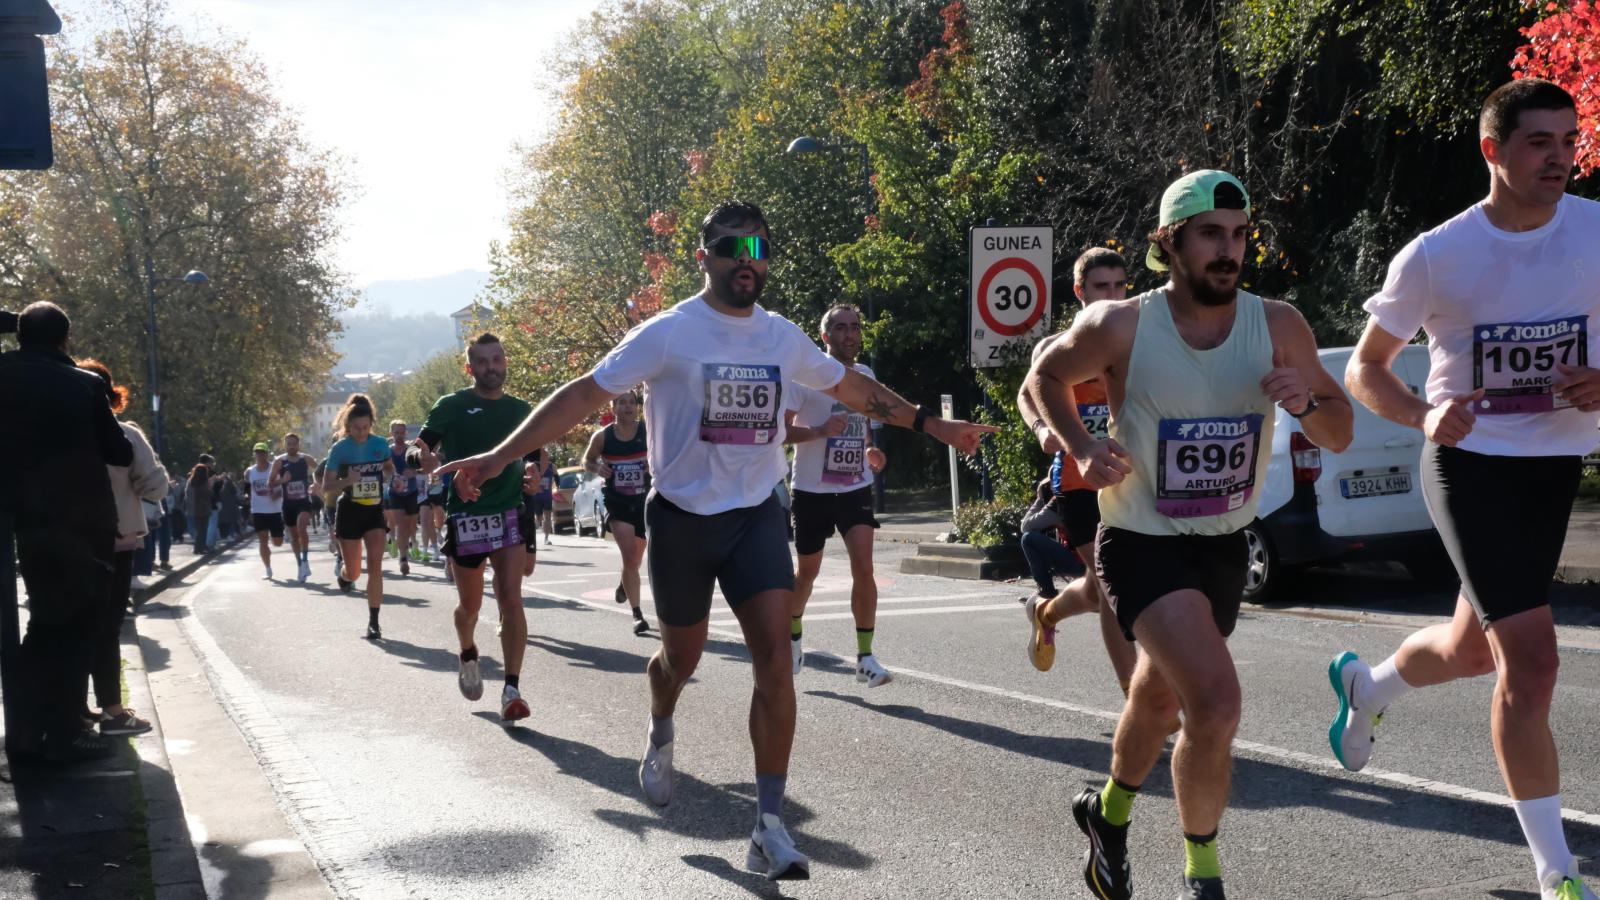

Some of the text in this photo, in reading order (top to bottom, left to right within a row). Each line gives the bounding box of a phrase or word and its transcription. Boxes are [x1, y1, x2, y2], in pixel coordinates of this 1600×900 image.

[984, 236, 1042, 251] GUNEA
[994, 285, 1032, 310] 30
[1485, 337, 1576, 373] 1057
[1512, 376, 1552, 387] MARC
[717, 384, 769, 408] 856
[715, 412, 770, 421] CRISNUNEZ
[833, 450, 861, 464] 805
[1176, 442, 1246, 474] 696
[617, 472, 640, 481] 923
[1185, 475, 1236, 489] ARTURO
[357, 482, 377, 492] 139
[1351, 477, 1408, 494] 3924 KHH
[458, 516, 502, 533] 1313
